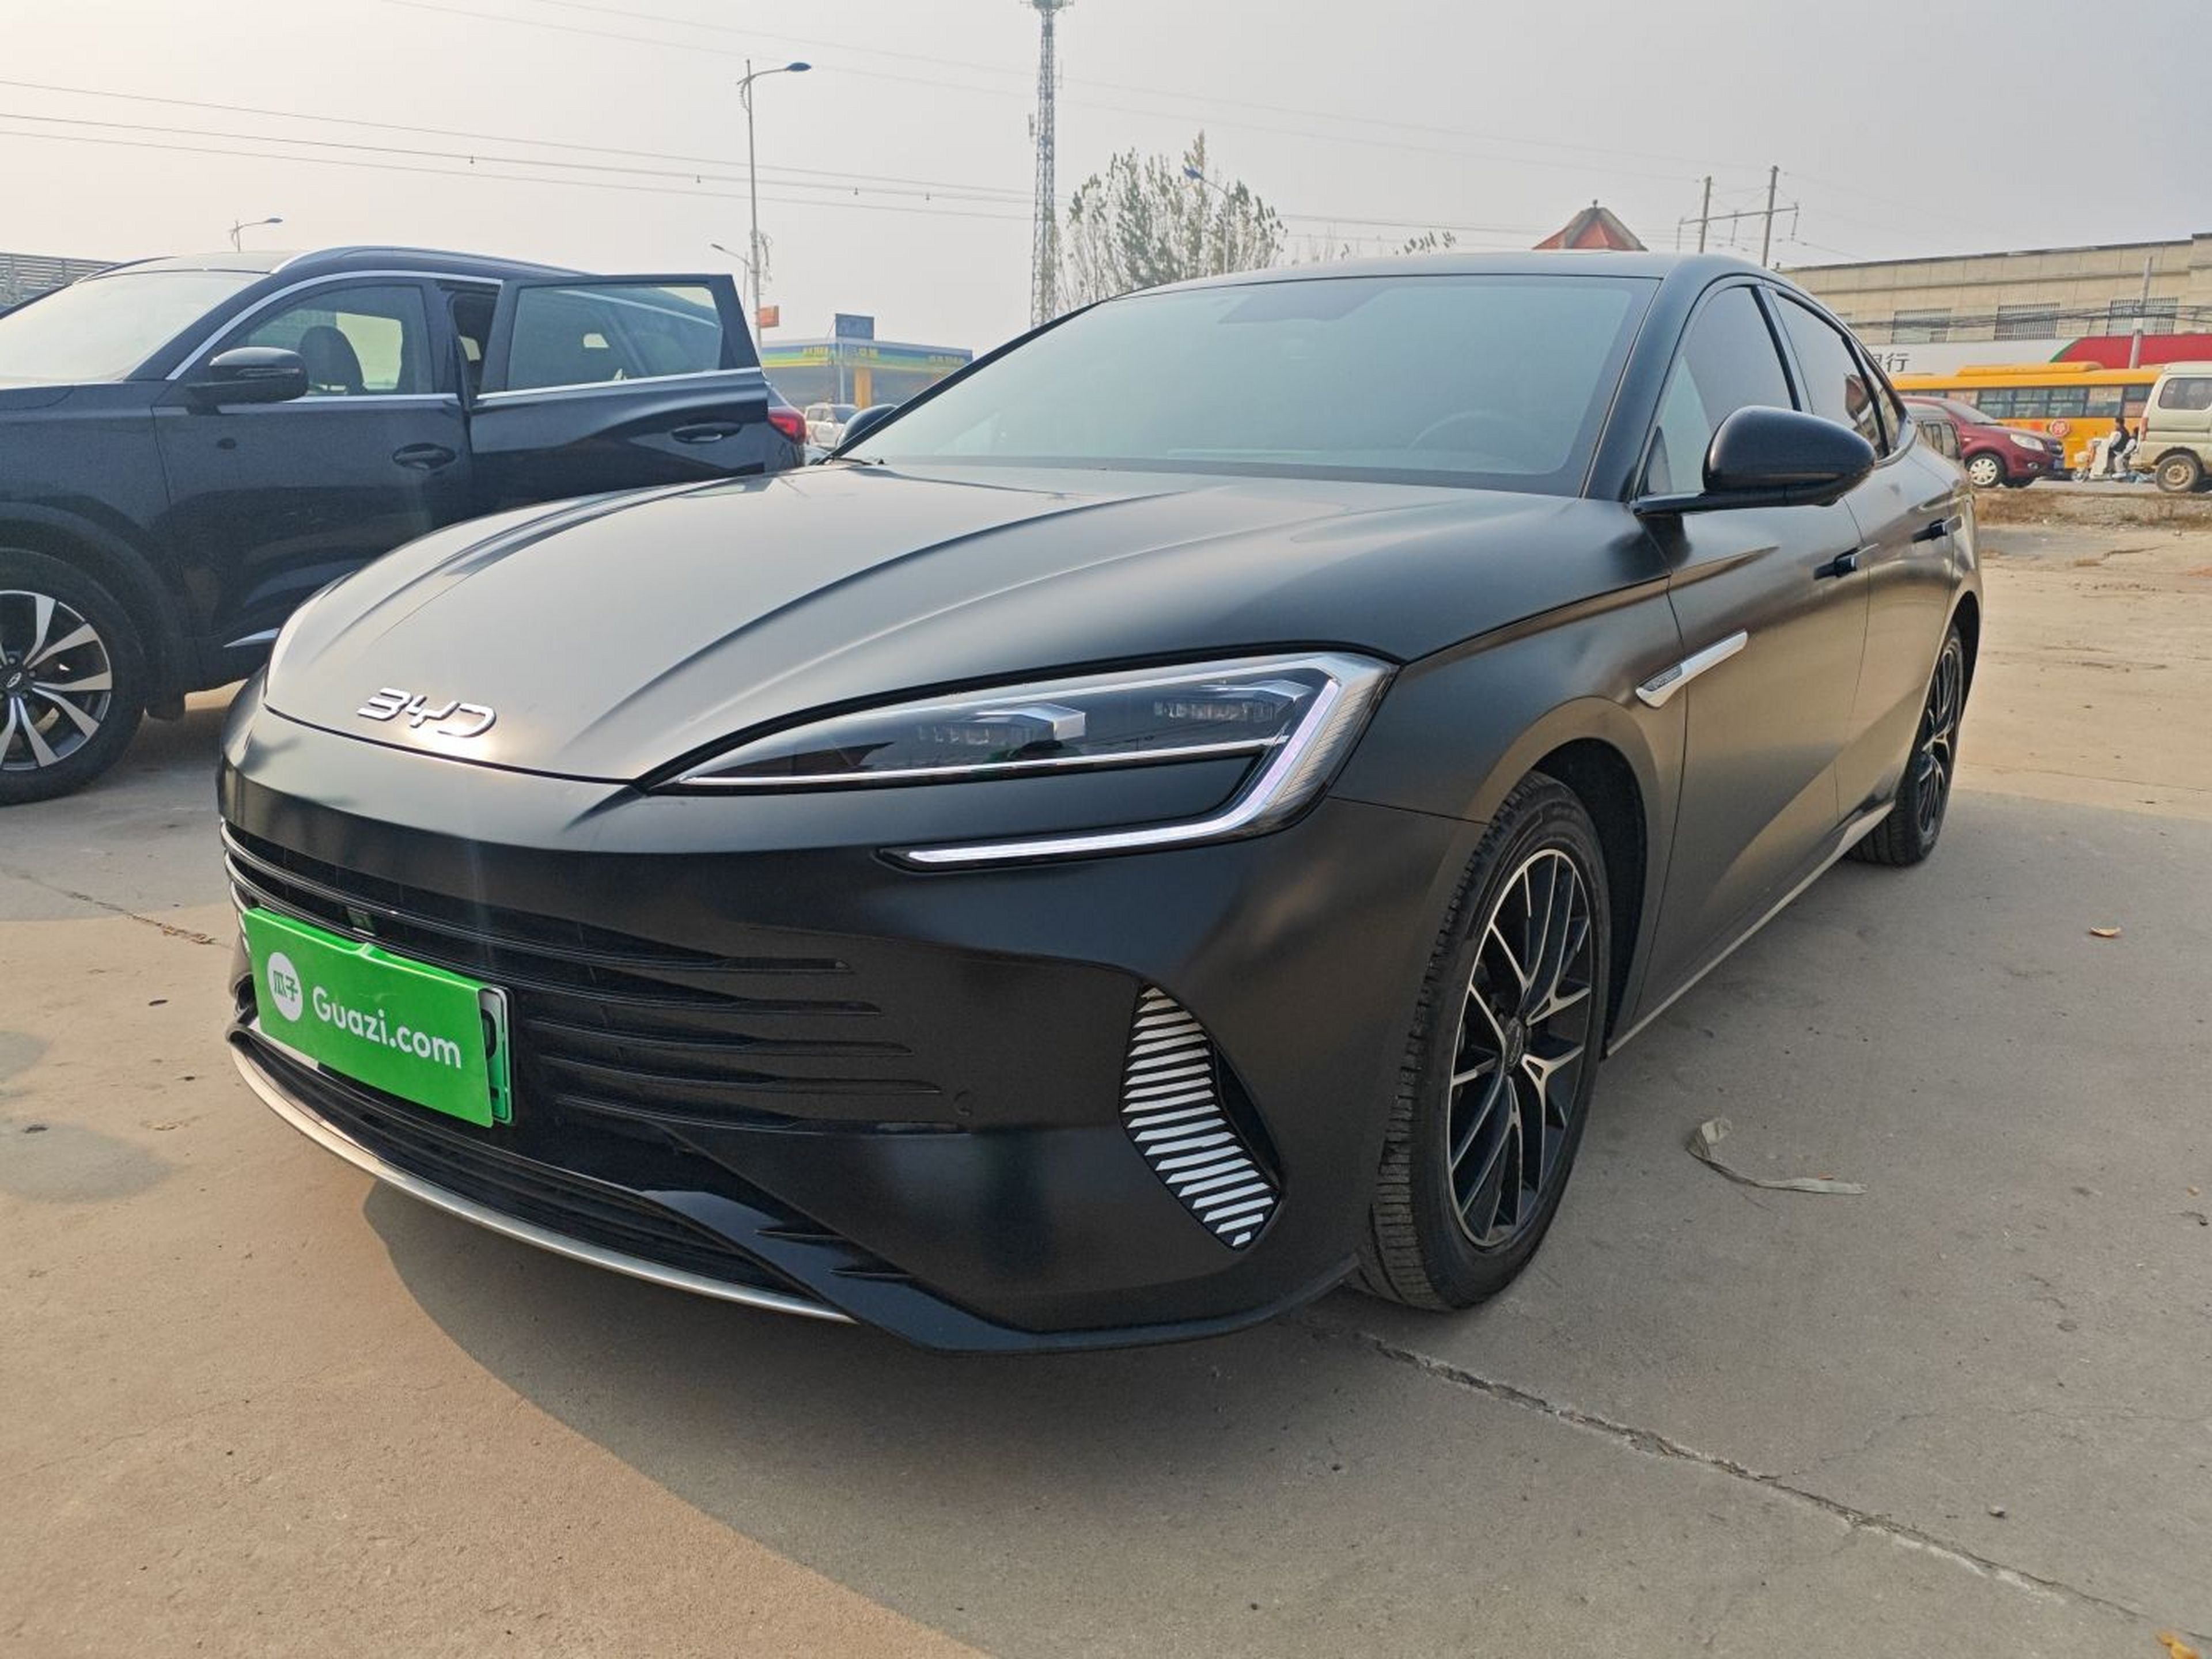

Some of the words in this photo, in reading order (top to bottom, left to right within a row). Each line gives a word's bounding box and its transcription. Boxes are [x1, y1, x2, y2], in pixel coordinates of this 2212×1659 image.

[357, 687, 496, 737] BYD
[273, 970, 298, 1002] 瓜子
[313, 984, 461, 1069] Guazi.com
